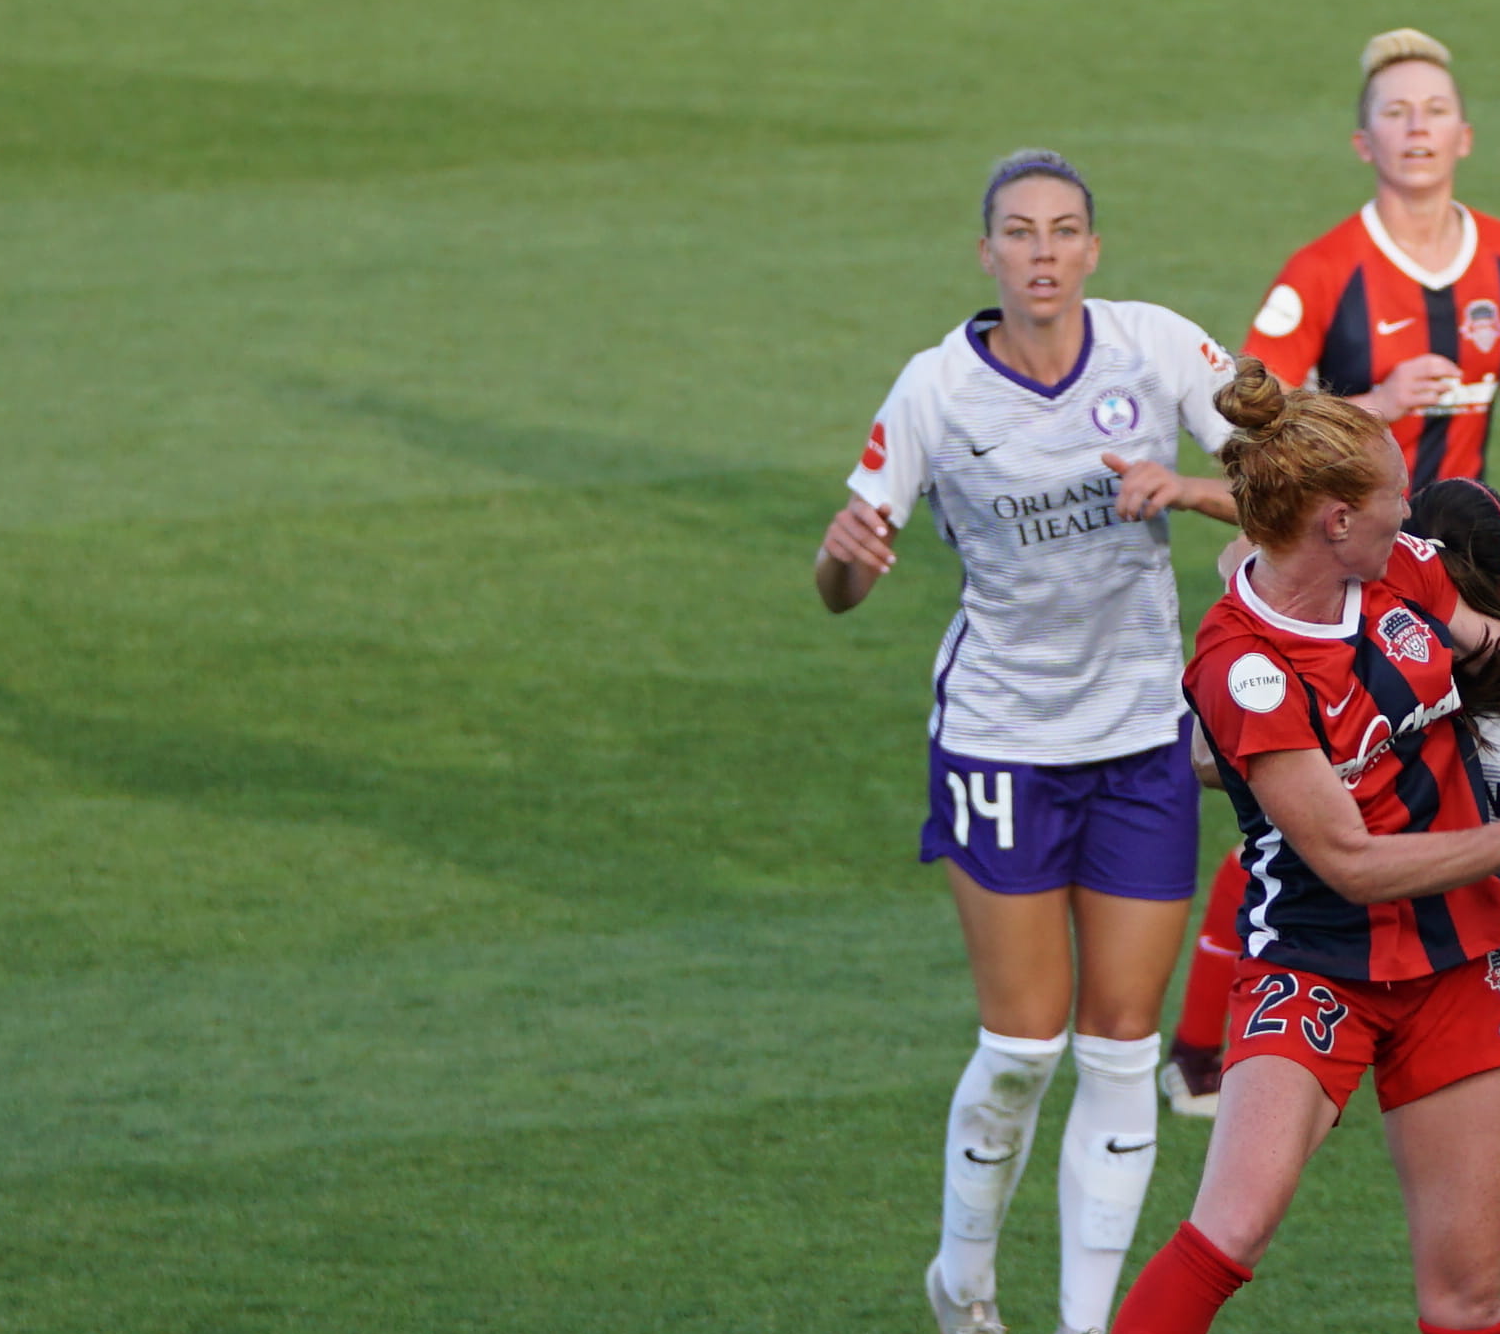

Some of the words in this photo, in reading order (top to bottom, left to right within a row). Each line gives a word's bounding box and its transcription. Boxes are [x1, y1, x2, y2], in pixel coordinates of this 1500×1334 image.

[993, 475, 1122, 519] ORLAN
[1016, 504, 1116, 546] HEALT
[1234, 674, 1282, 694] LIFETIME
[946, 771, 1014, 849] 14
[1243, 972, 1349, 1054] 23
